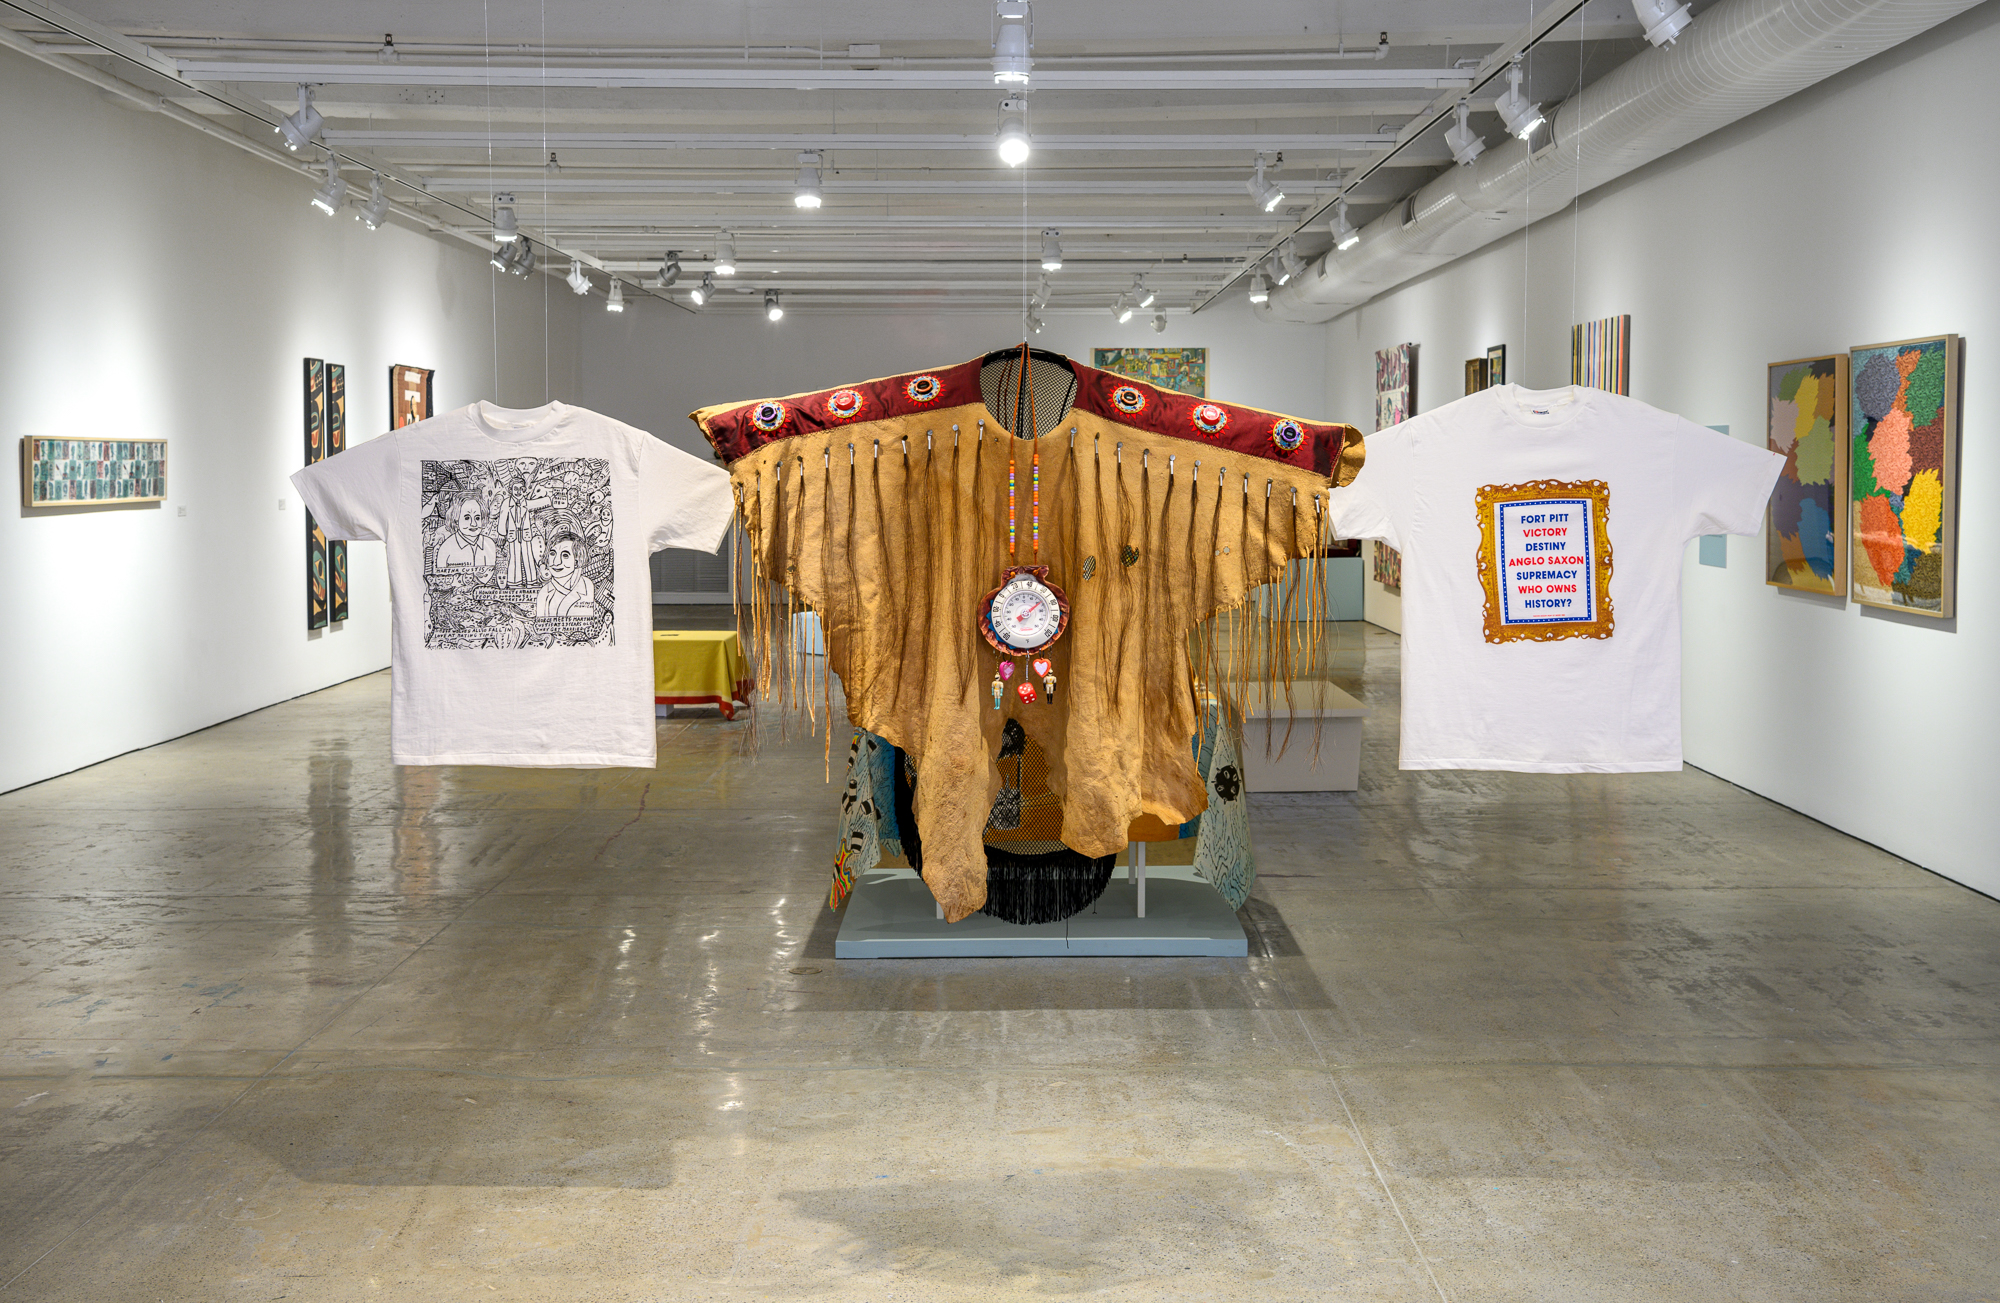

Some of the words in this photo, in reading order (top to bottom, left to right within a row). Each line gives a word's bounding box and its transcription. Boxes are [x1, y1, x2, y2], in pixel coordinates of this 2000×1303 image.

[1521, 515, 1545, 524] FORT
[1550, 514, 1568, 522] PITT
[1523, 528, 1567, 537] VICTORY
[1526, 542, 1565, 551] DESTINY
[1509, 557, 1545, 567] ANGLO
[1548, 556, 1584, 565] SAXON
[1517, 570, 1577, 580] SUPREMACY
[1518, 585, 1543, 594] WHO
[1546, 584, 1577, 593] OWNS
[1525, 599, 1571, 608] HISTORY?
